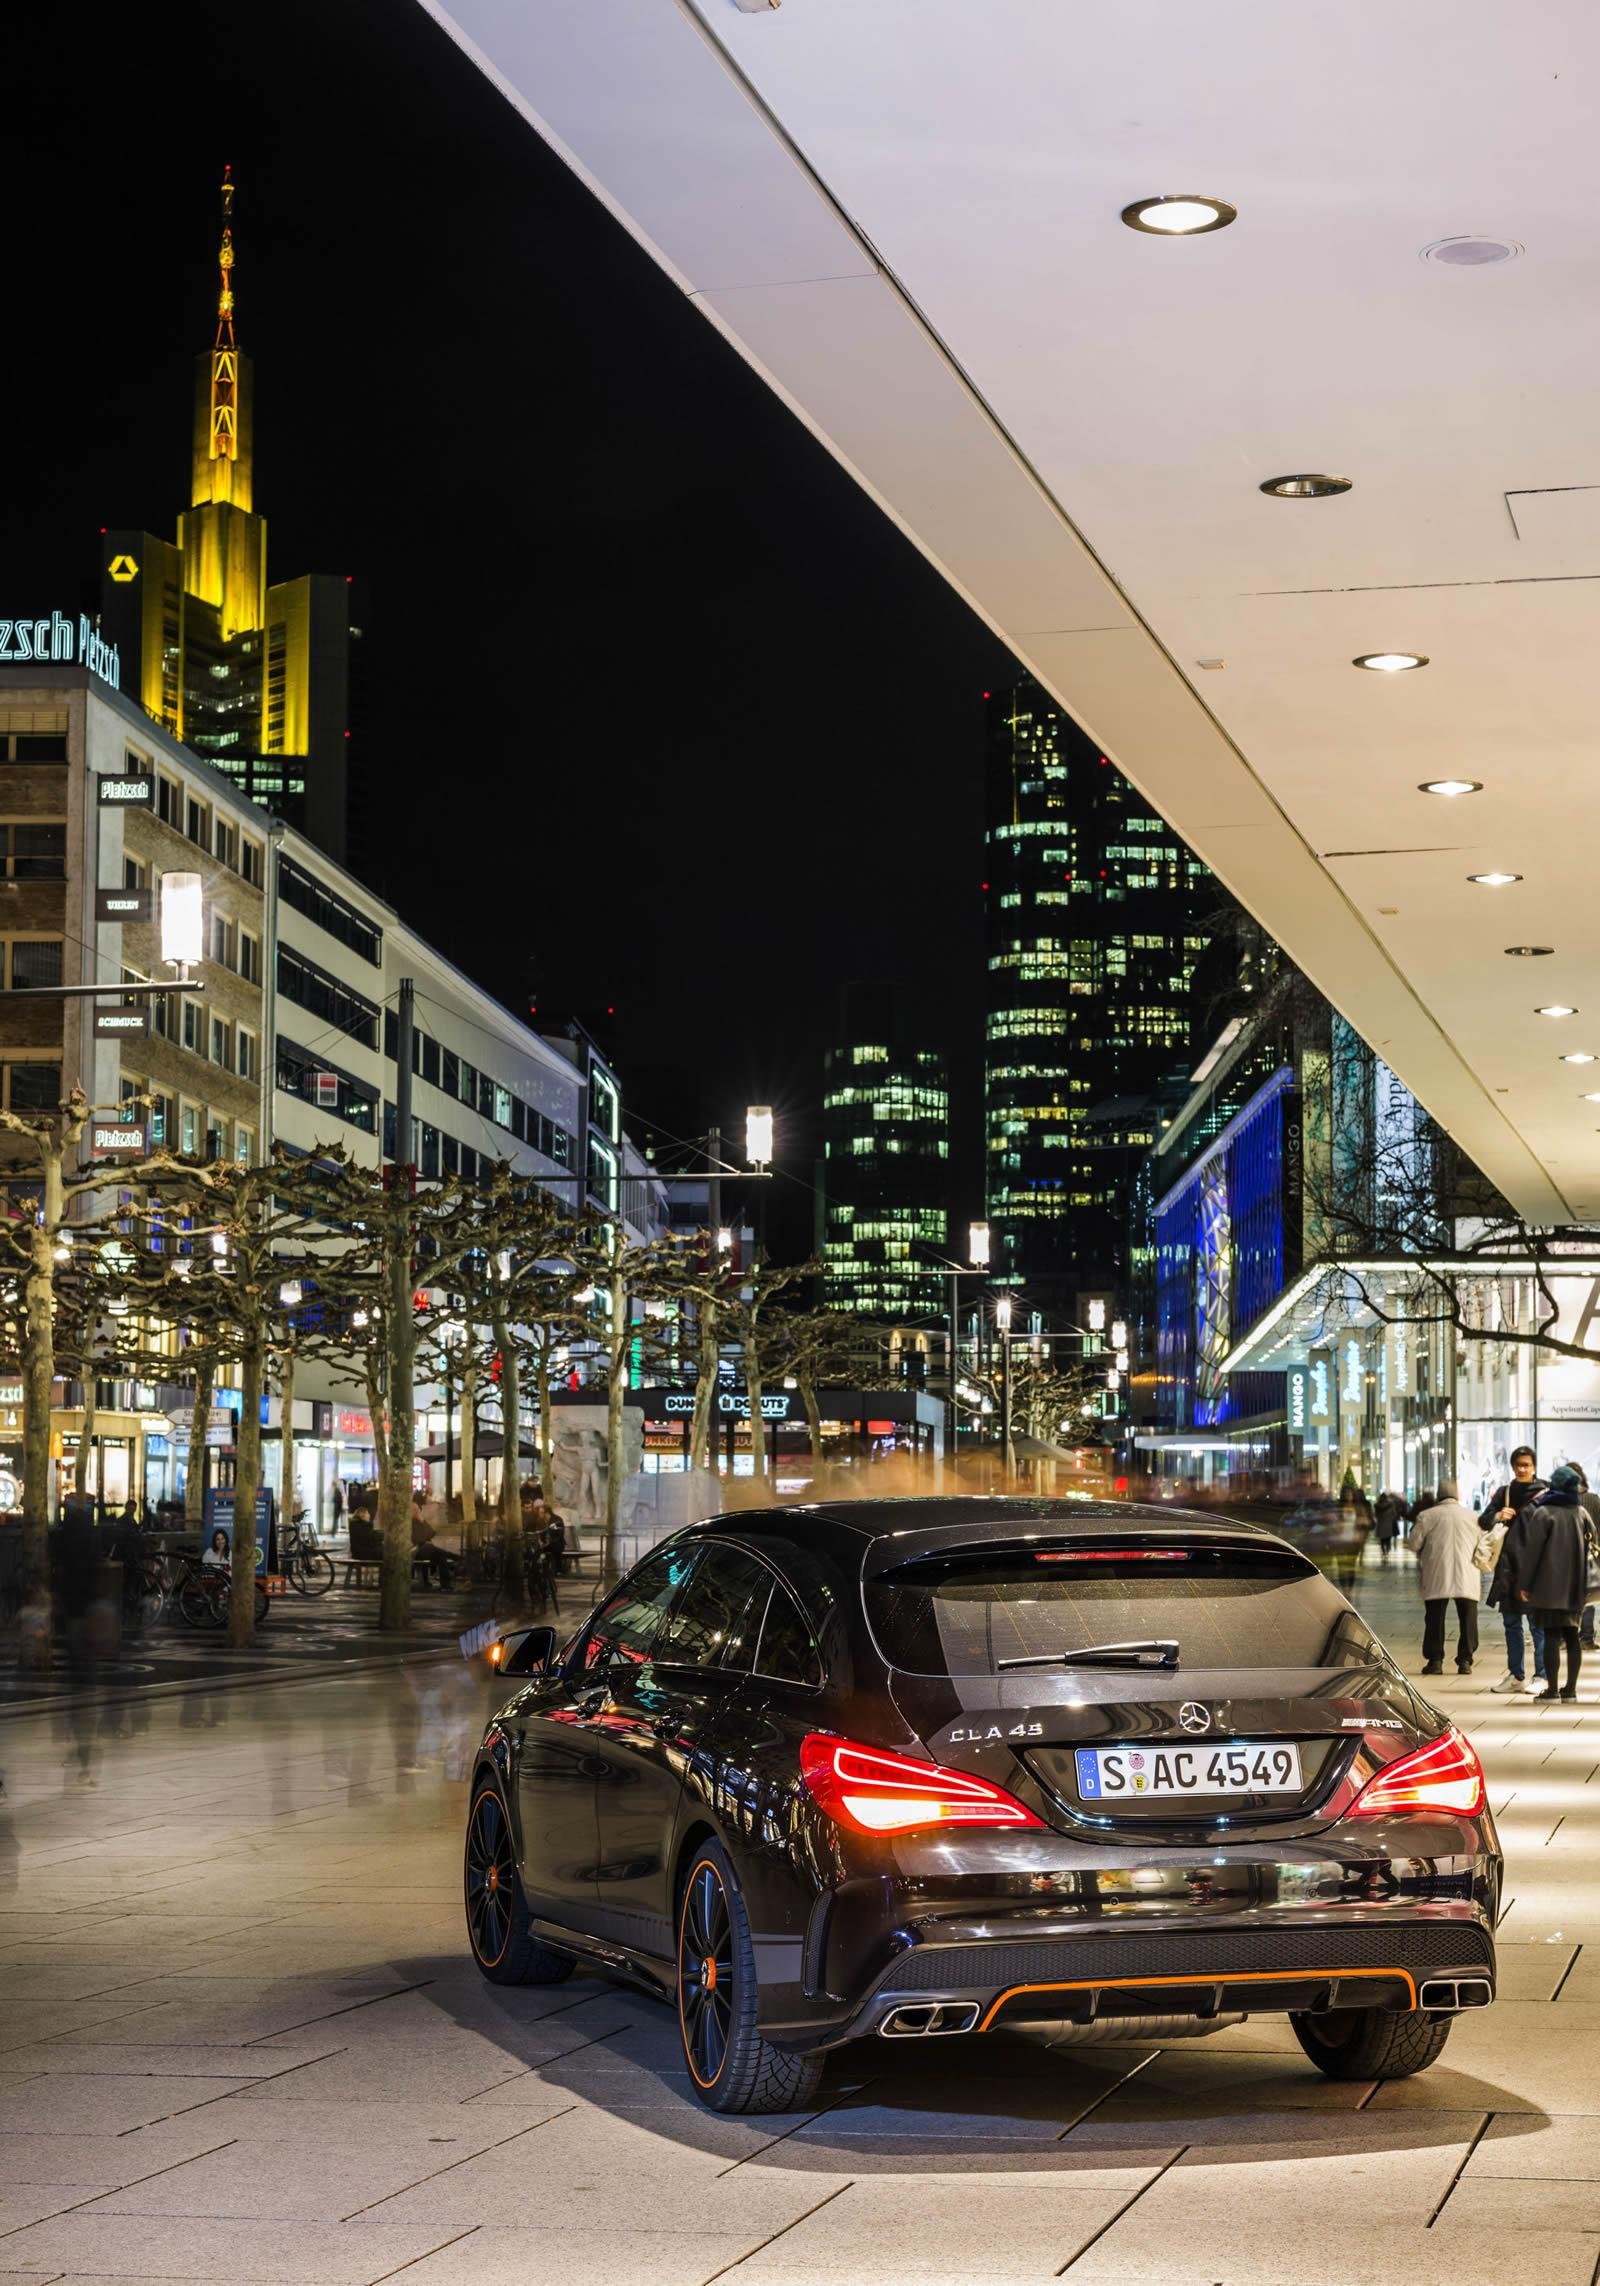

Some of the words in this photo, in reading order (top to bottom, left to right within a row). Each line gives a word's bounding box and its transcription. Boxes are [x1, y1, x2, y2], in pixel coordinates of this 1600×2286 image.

[1288, 1124, 1300, 1196] MANGO
[1292, 1373, 1304, 1427] MANGO
[950, 1726, 1003, 1742] CLA
[1009, 1723, 1043, 1737] 45
[1364, 1719, 1403, 1729] AMG
[1087, 1779, 1095, 1790] D
[1103, 1756, 1126, 1791] S
[1153, 1752, 1198, 1790] AC
[1207, 1749, 1293, 1788] 4549
